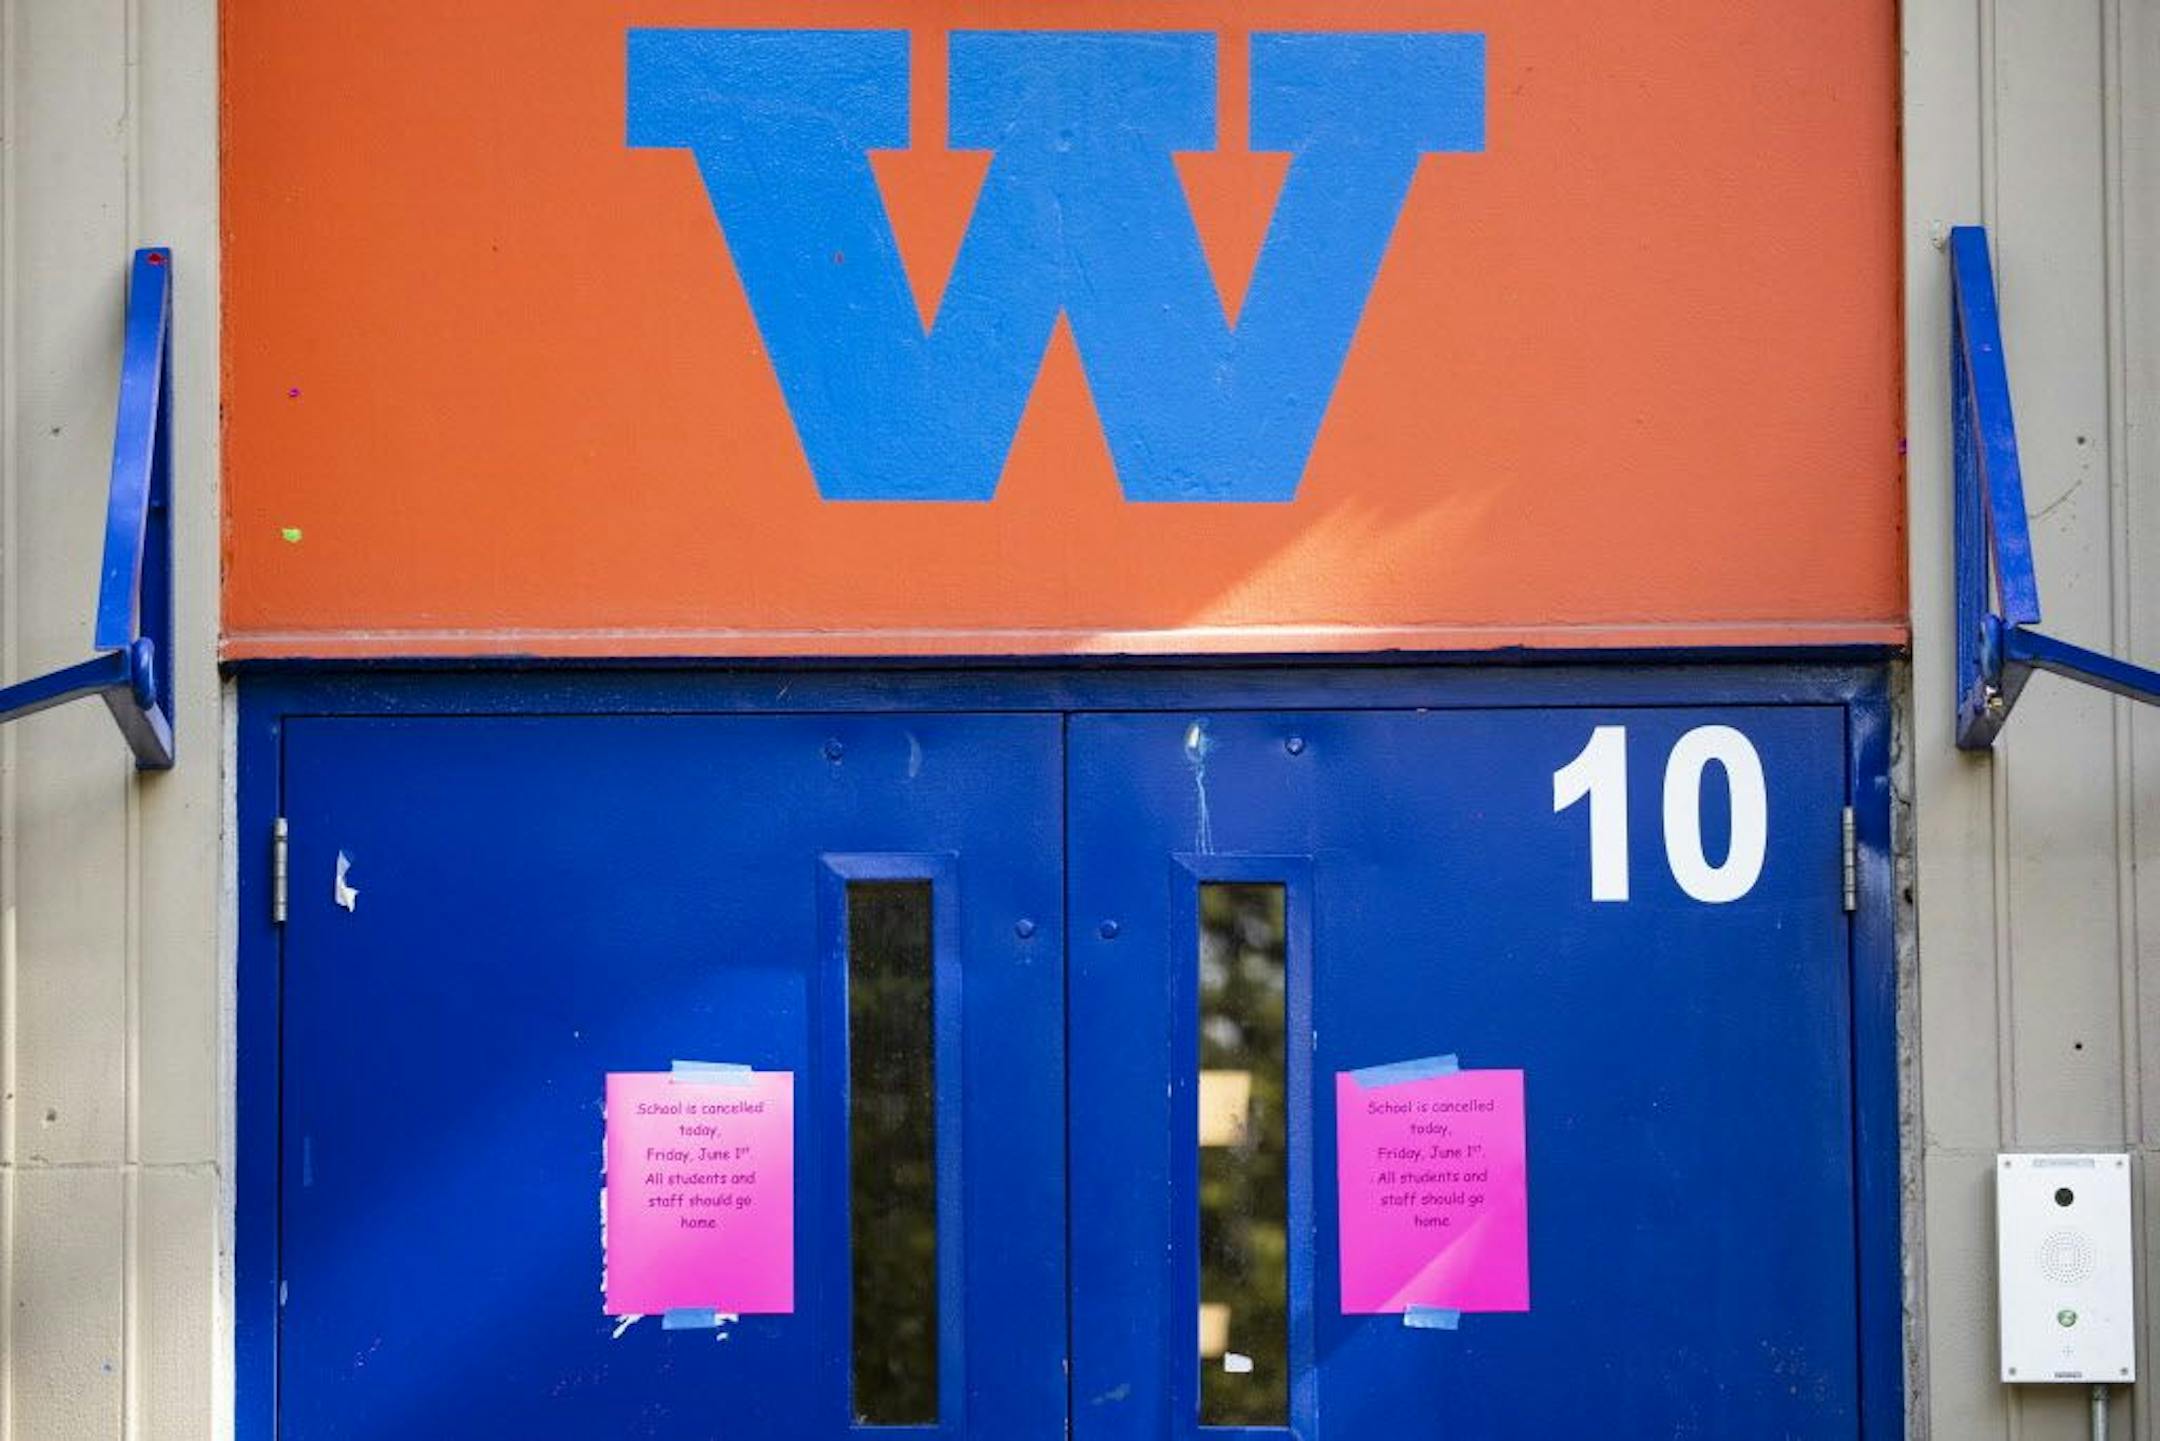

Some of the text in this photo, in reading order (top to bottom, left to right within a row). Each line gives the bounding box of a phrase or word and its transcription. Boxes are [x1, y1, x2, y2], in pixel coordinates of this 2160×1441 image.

[627, 30, 1486, 501] W
[1553, 725, 1767, 903] 10
[637, 1102, 764, 1114] School is cancelled
[1368, 1100, 1494, 1113] School is cancelled
[1411, 1123, 1452, 1137] today,
[647, 1148, 693, 1162] Friday,
[698, 1148, 730, 1161] June
[1378, 1148, 1425, 1161] Friday,
[1429, 1147, 1462, 1159] June
[645, 1172, 755, 1185] All students and
[1378, 1170, 1488, 1183] All students and
[648, 1194, 752, 1209] staff should go
[1381, 1193, 1484, 1207] staff should go
